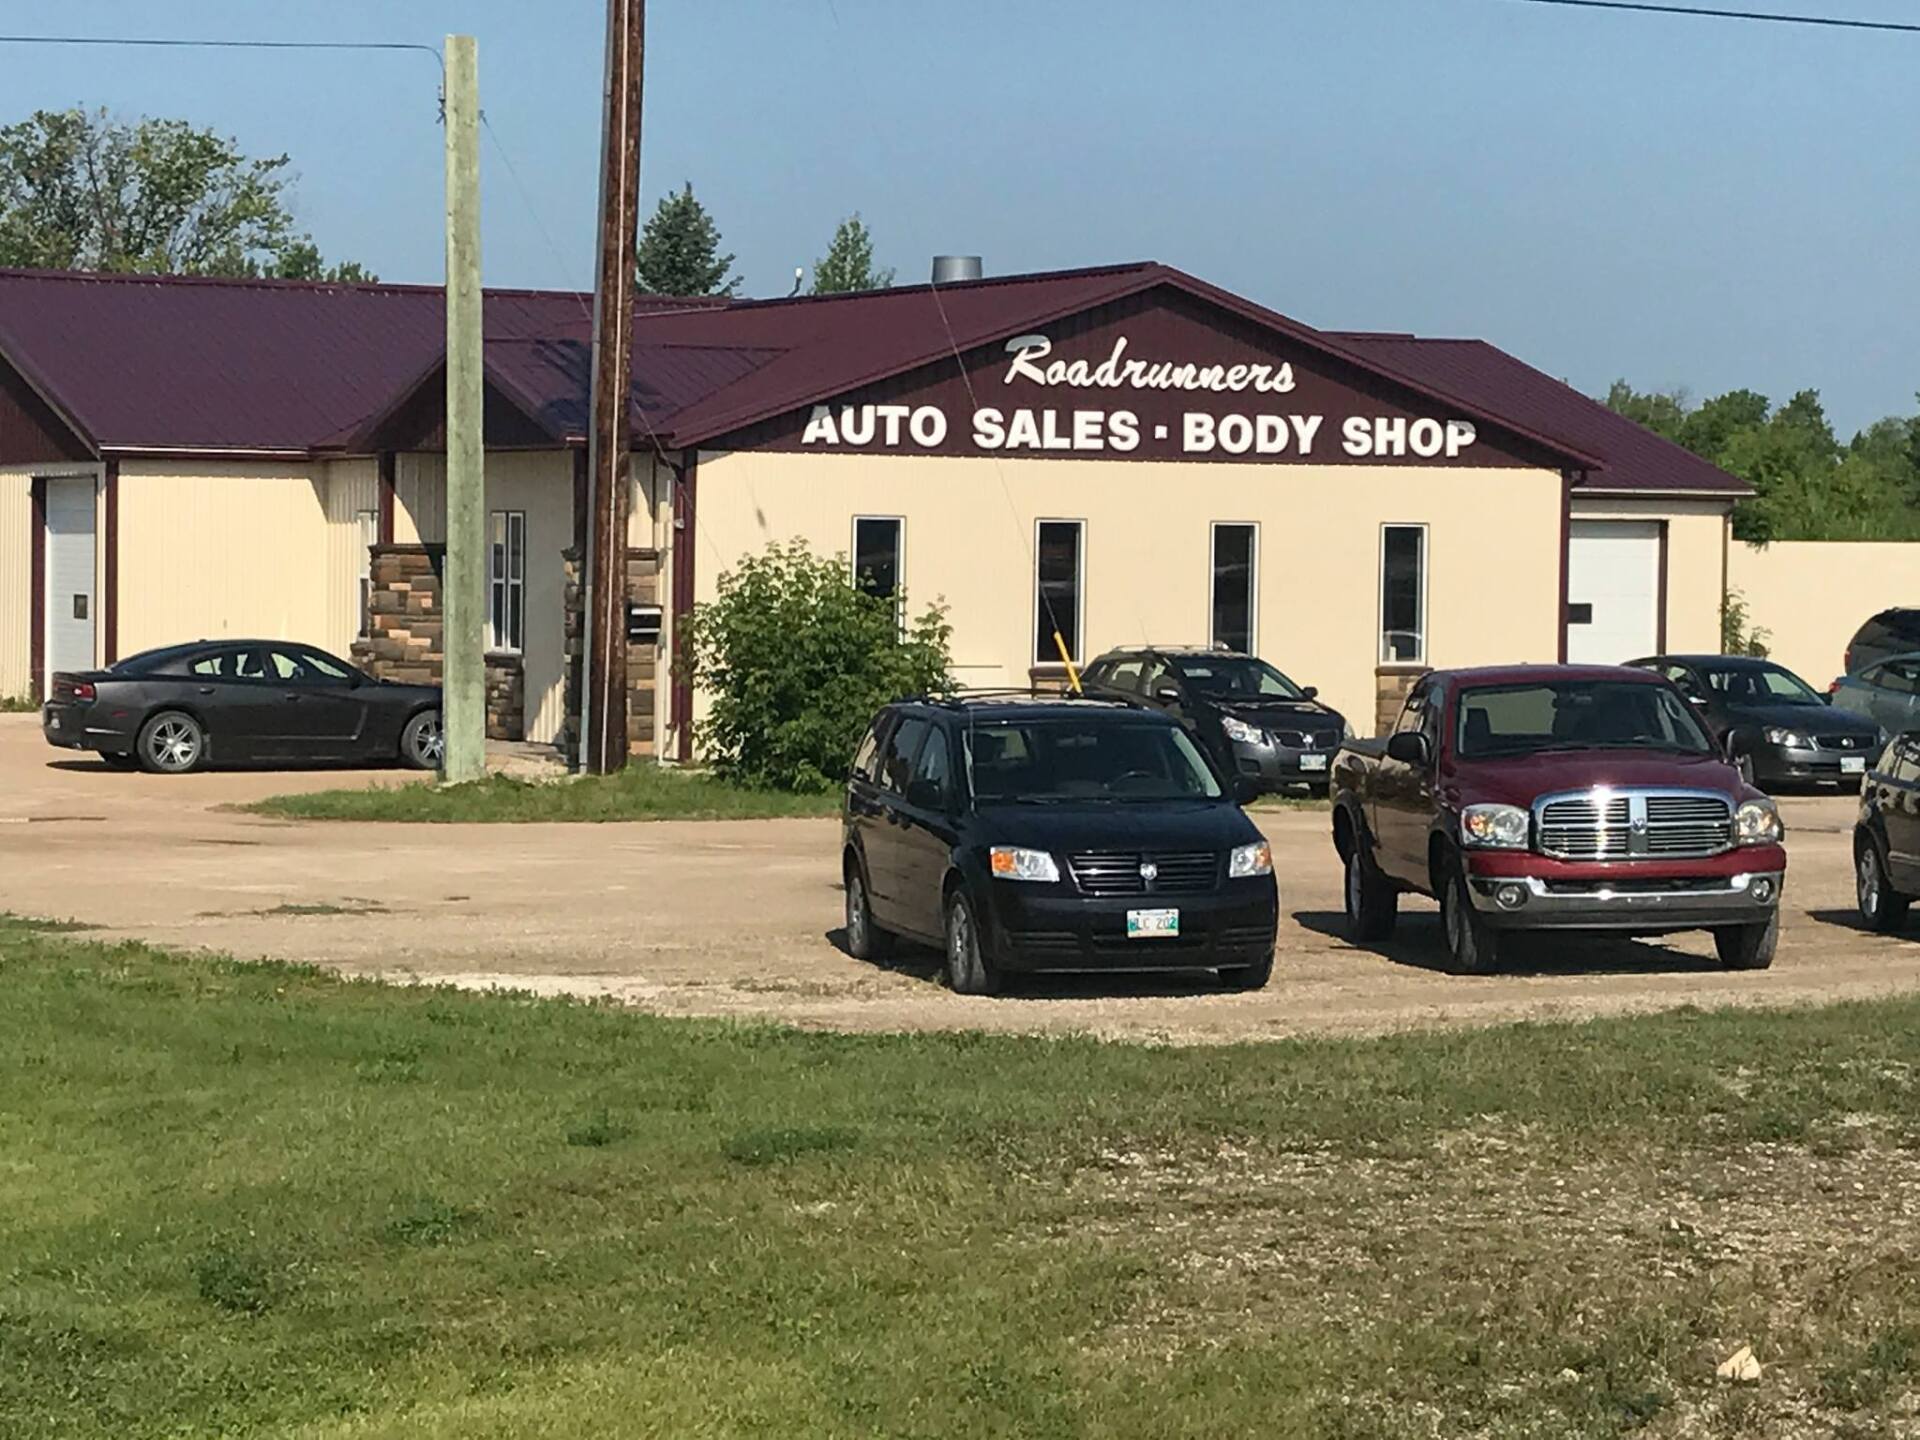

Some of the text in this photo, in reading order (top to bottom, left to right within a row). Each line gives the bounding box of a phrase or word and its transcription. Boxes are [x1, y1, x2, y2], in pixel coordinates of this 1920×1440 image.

[1004, 335, 1296, 393] Roadrunners
[801, 404, 1476, 458] AUTO SALES BODY SHOP
